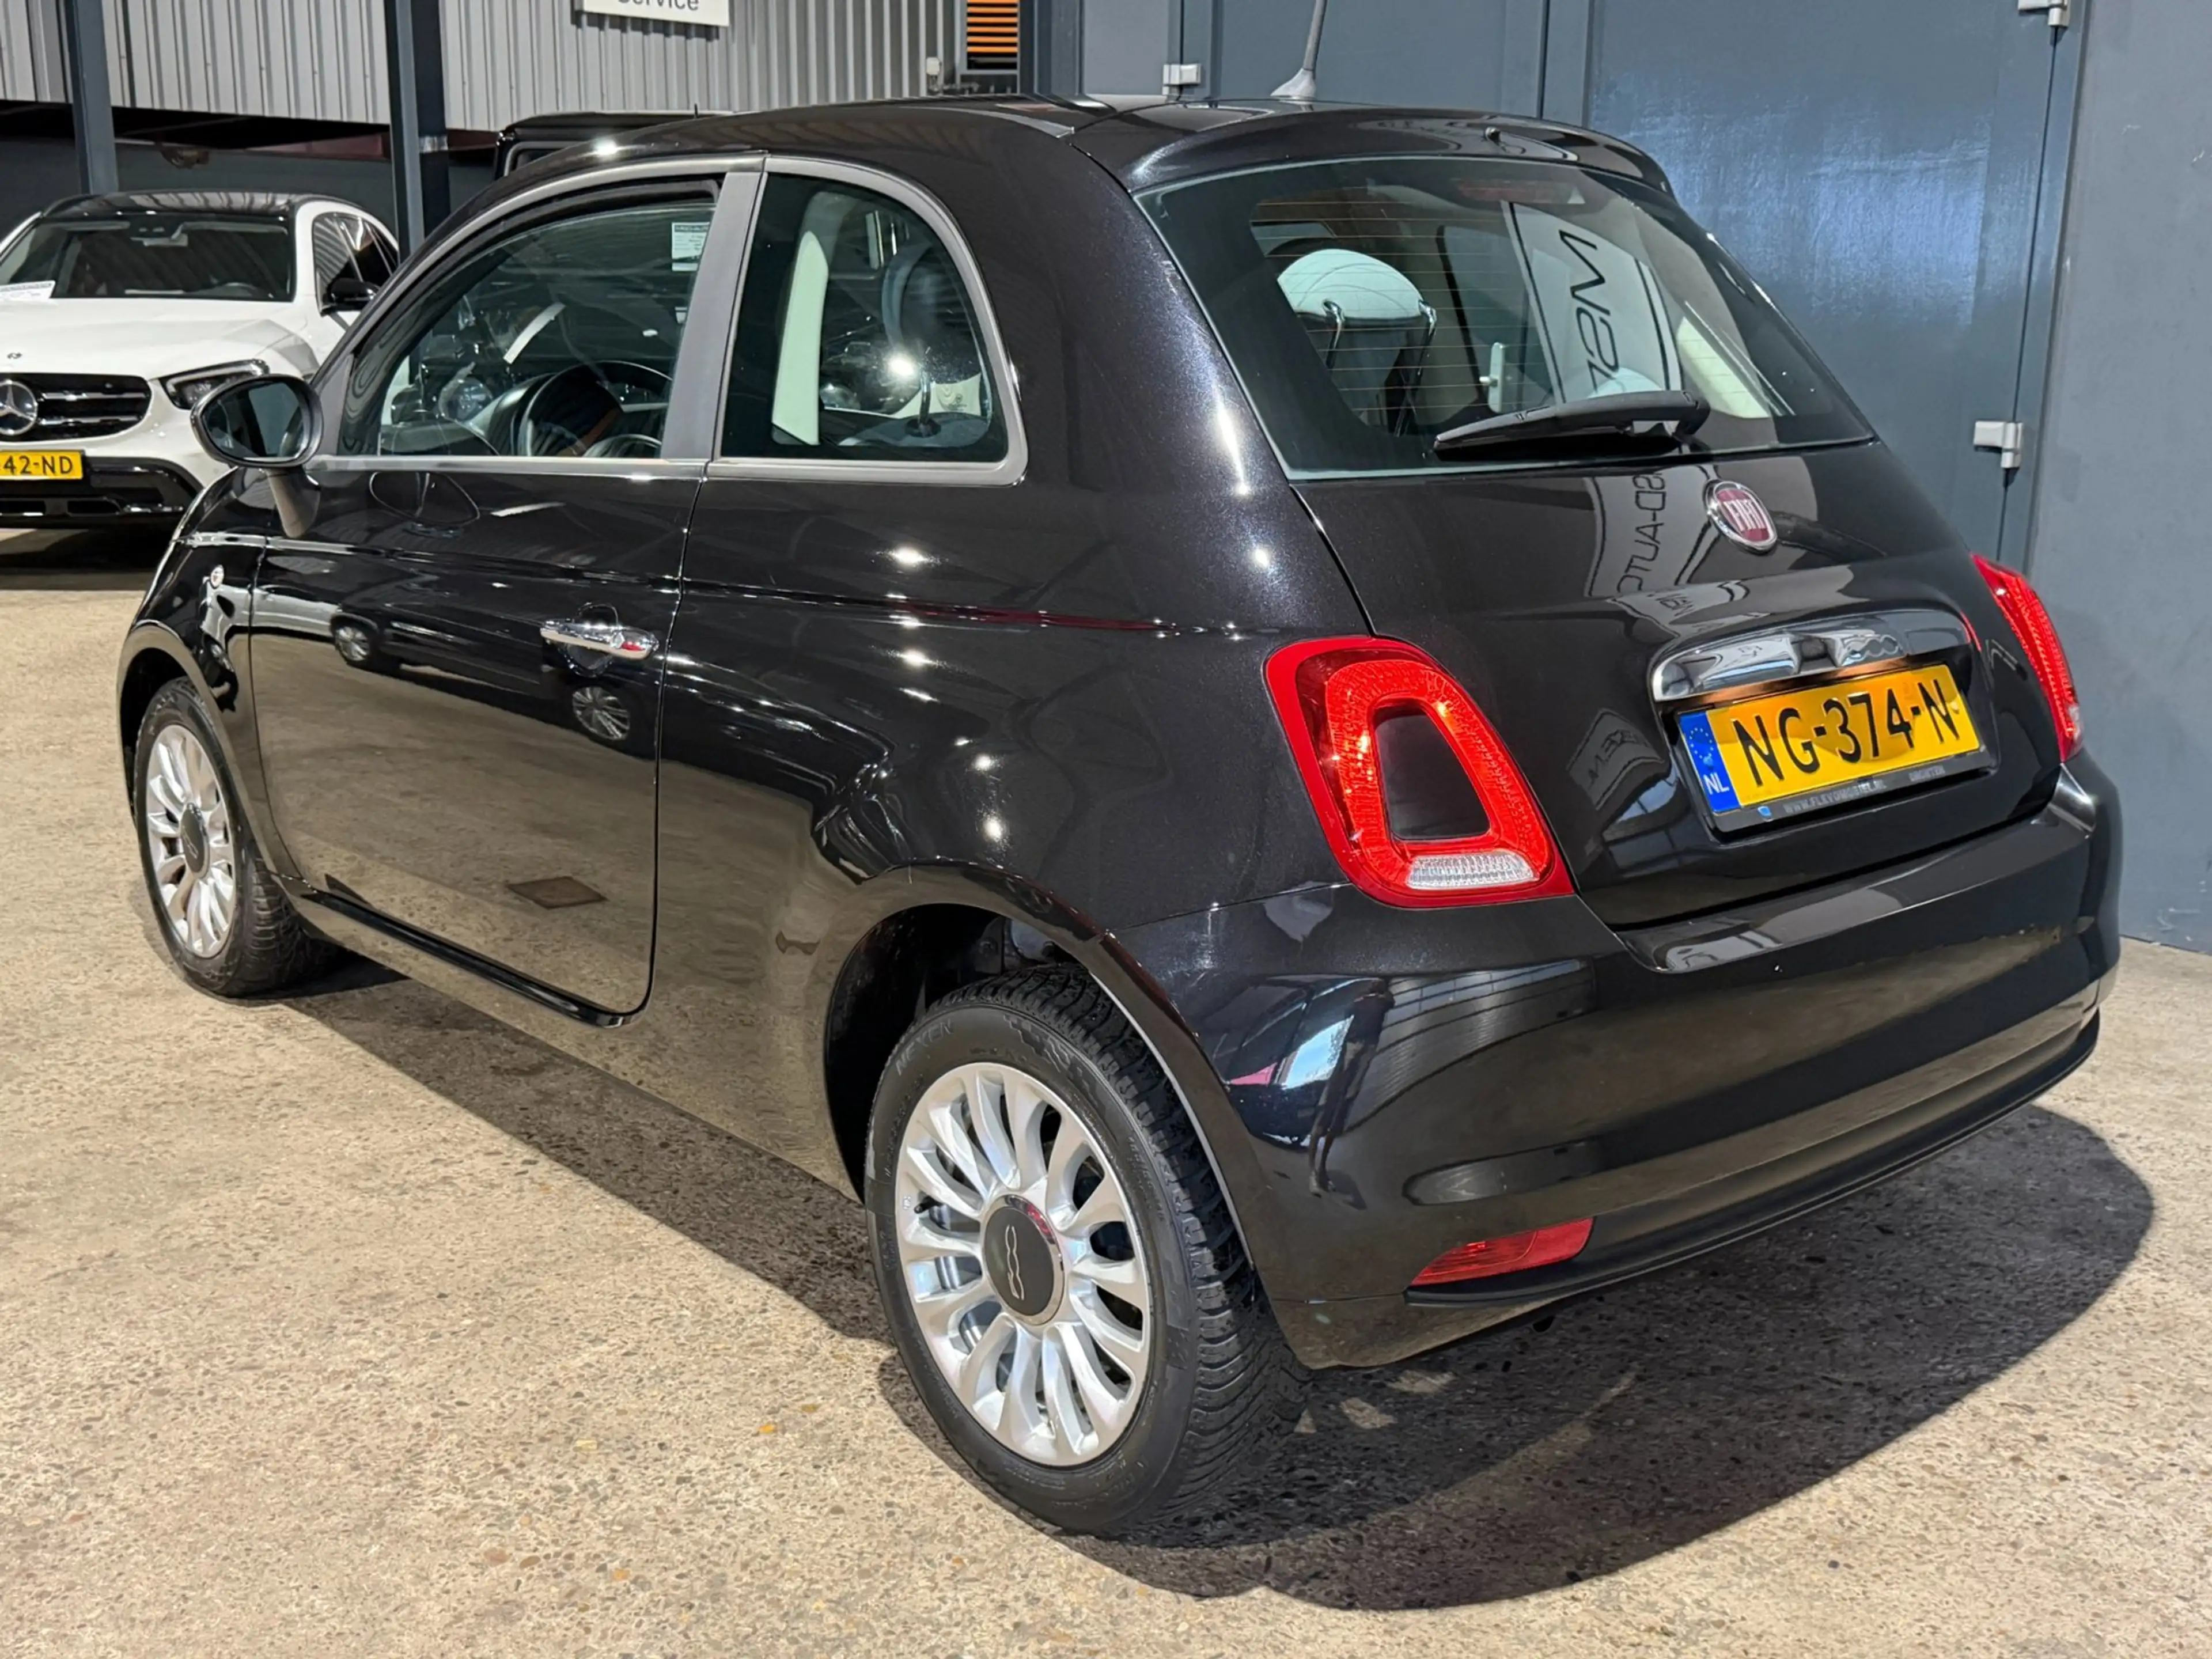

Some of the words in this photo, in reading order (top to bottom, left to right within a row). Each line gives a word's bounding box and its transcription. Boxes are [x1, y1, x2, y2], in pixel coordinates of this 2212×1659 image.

[3, 454, 73, 475] 42-ND
[1723, 498, 1766, 531] FIAT
[1732, 679, 1960, 787] NG-374-N
[1703, 773, 1729, 794] NL
